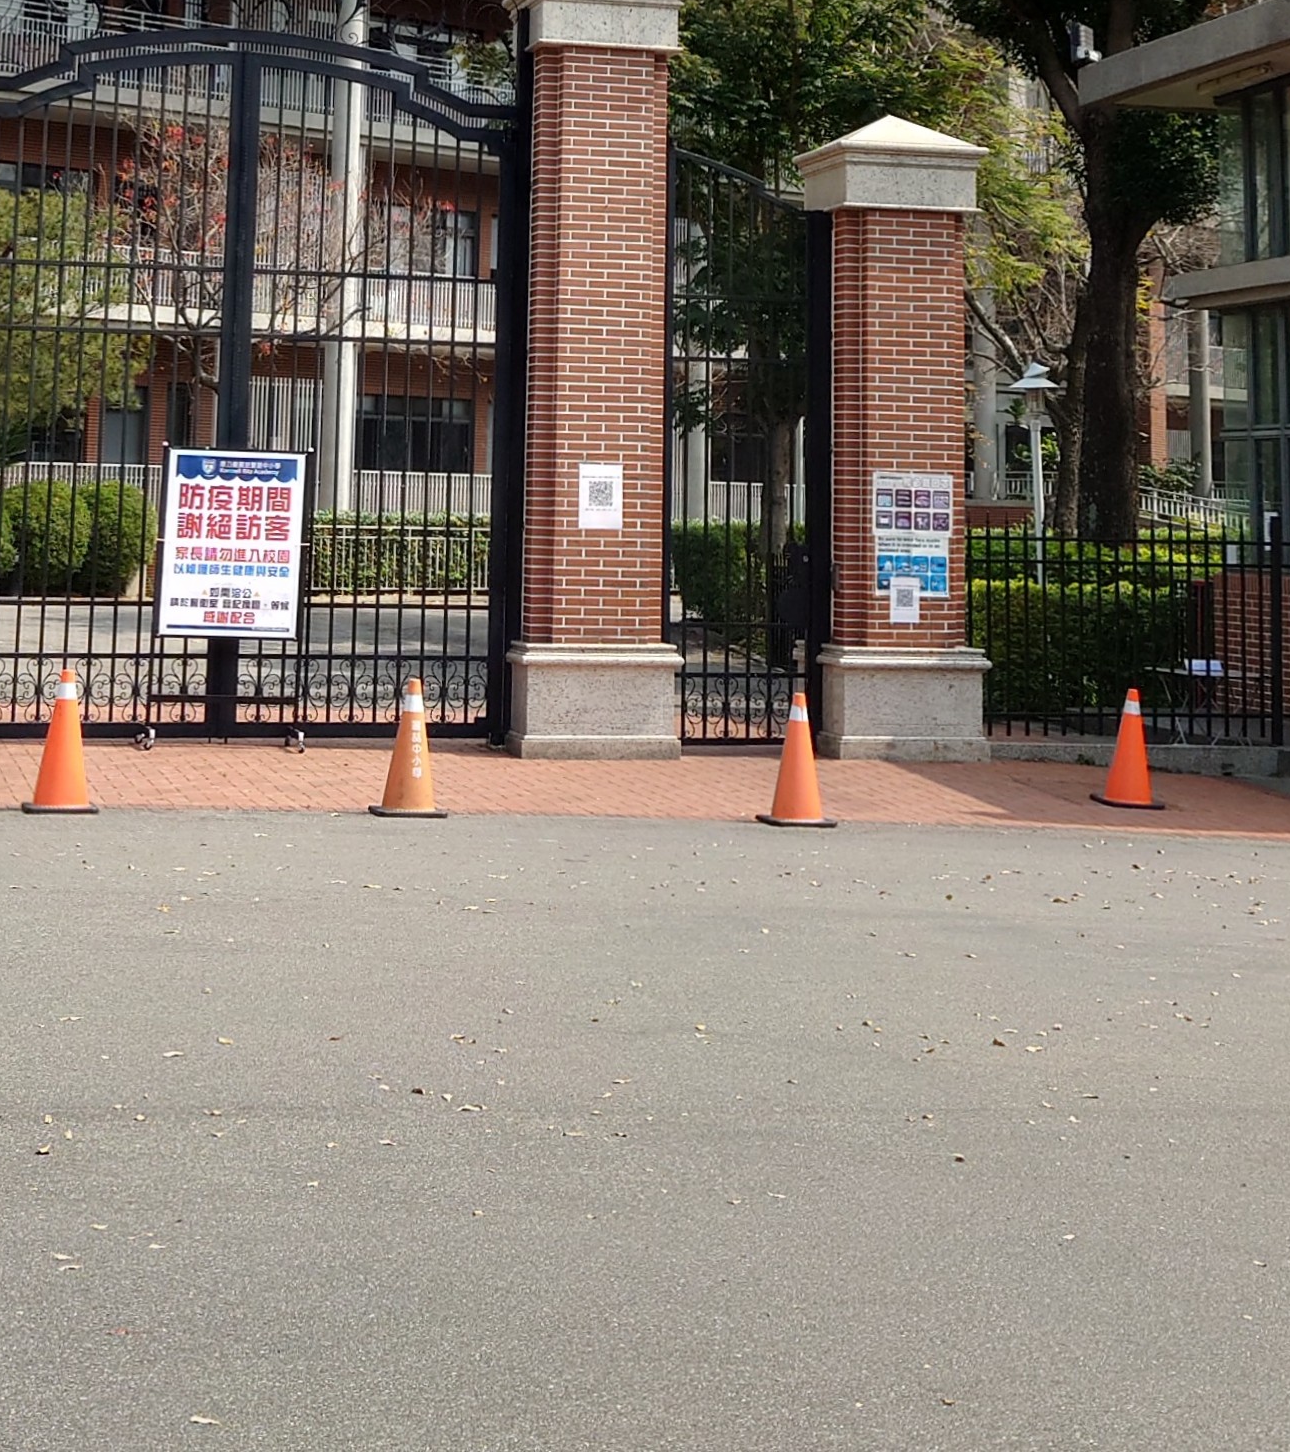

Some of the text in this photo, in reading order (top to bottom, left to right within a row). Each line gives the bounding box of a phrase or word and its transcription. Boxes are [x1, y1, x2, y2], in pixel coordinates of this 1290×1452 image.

[179, 483, 291, 512] 防疫期間
[177, 513, 290, 541] 謝絕訪客
[175, 547, 290, 563] 家長請勿進入校園
[203, 611, 255, 624] 感謝配合
